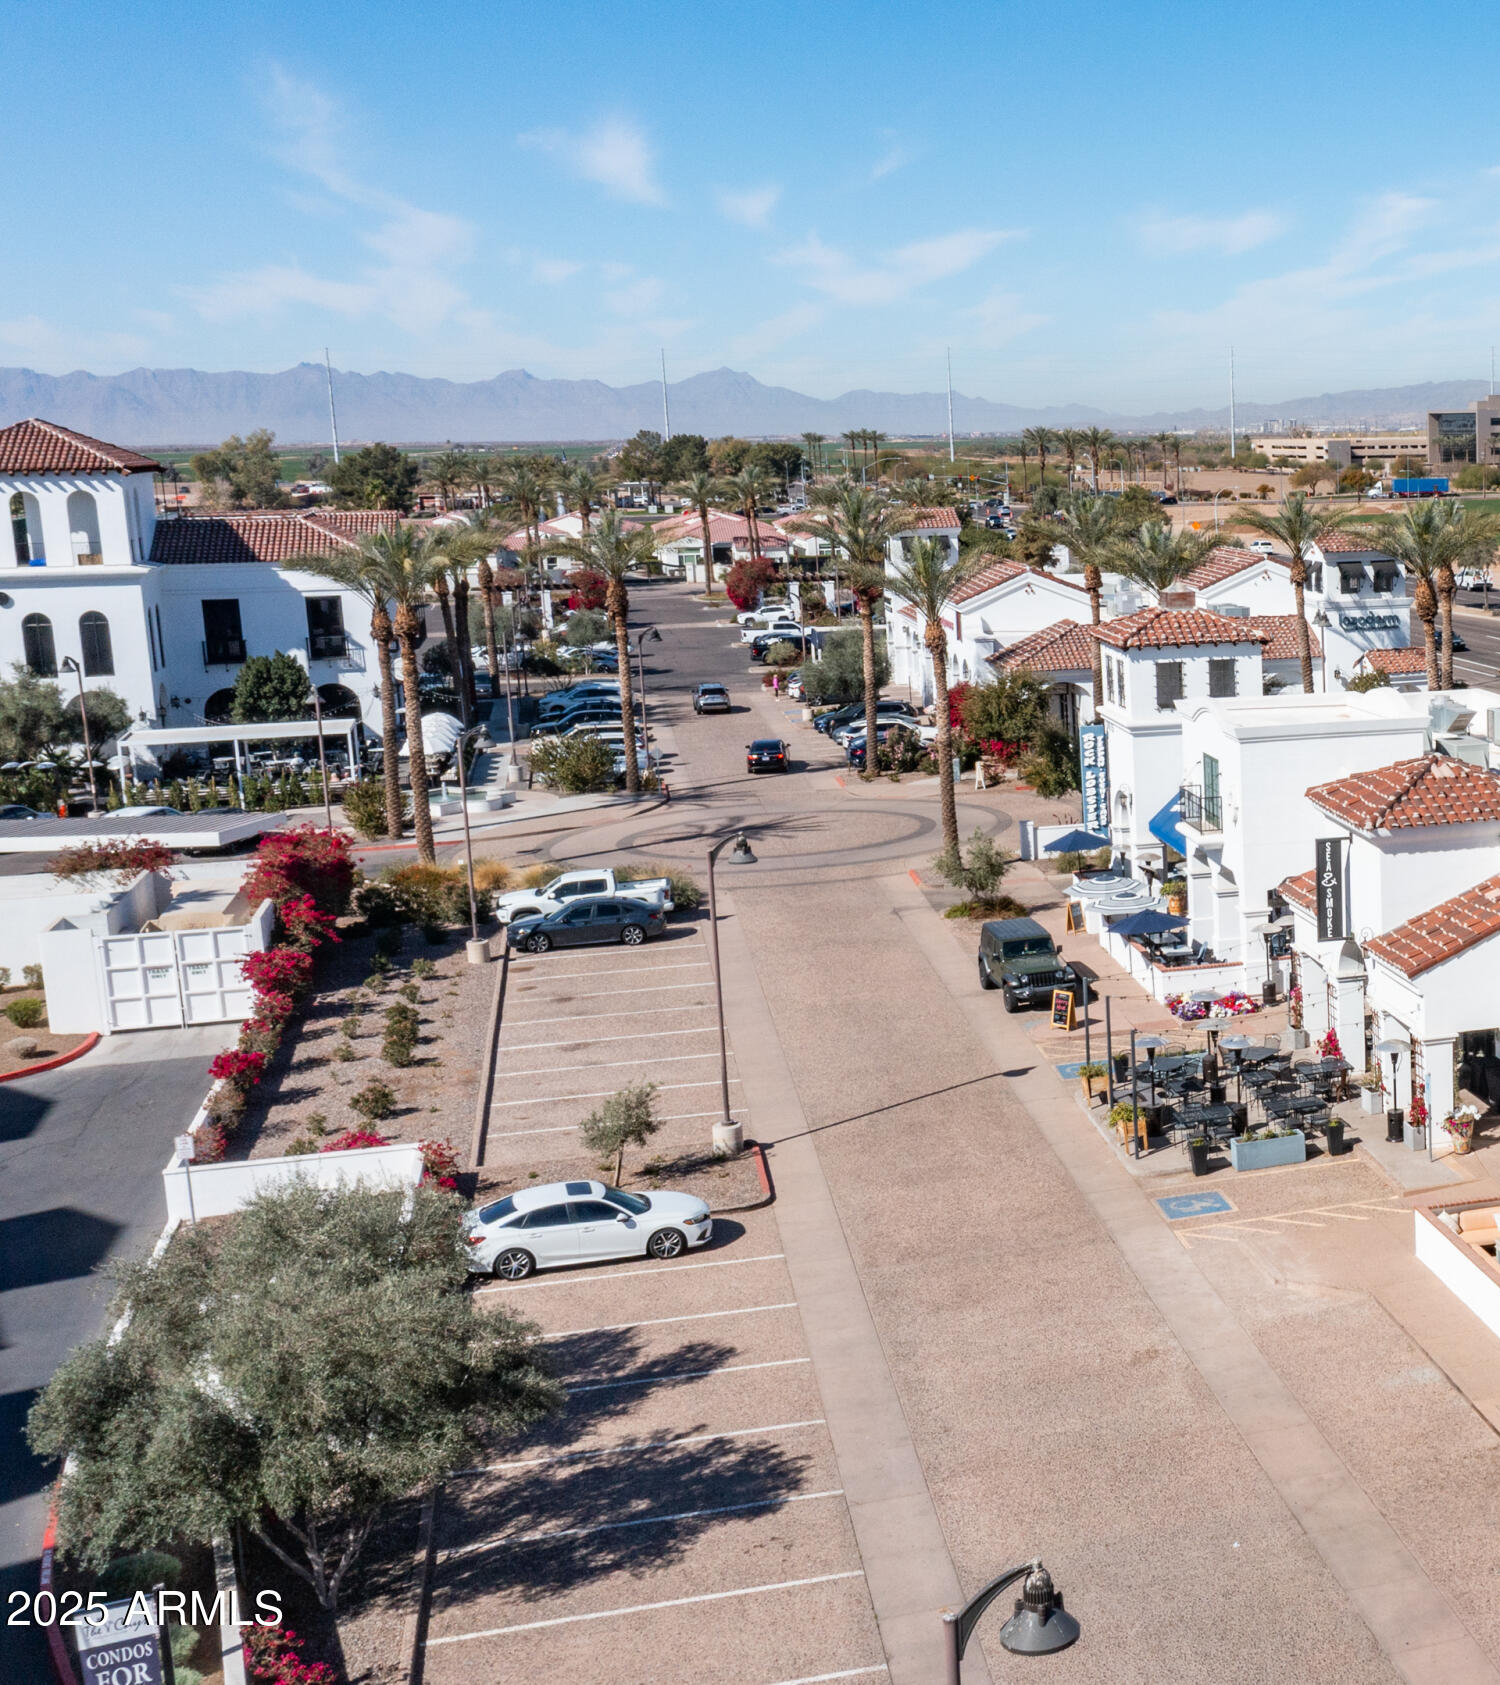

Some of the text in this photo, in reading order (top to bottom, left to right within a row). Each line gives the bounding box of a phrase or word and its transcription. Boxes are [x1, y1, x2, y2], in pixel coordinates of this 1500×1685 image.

[1082, 733, 1100, 830] ROCK LOBSTER
[1321, 842, 1338, 938] SEA & SMOKE
[86, 1641, 153, 1670] CONDOS
[96, 1662, 153, 1685] FOR
